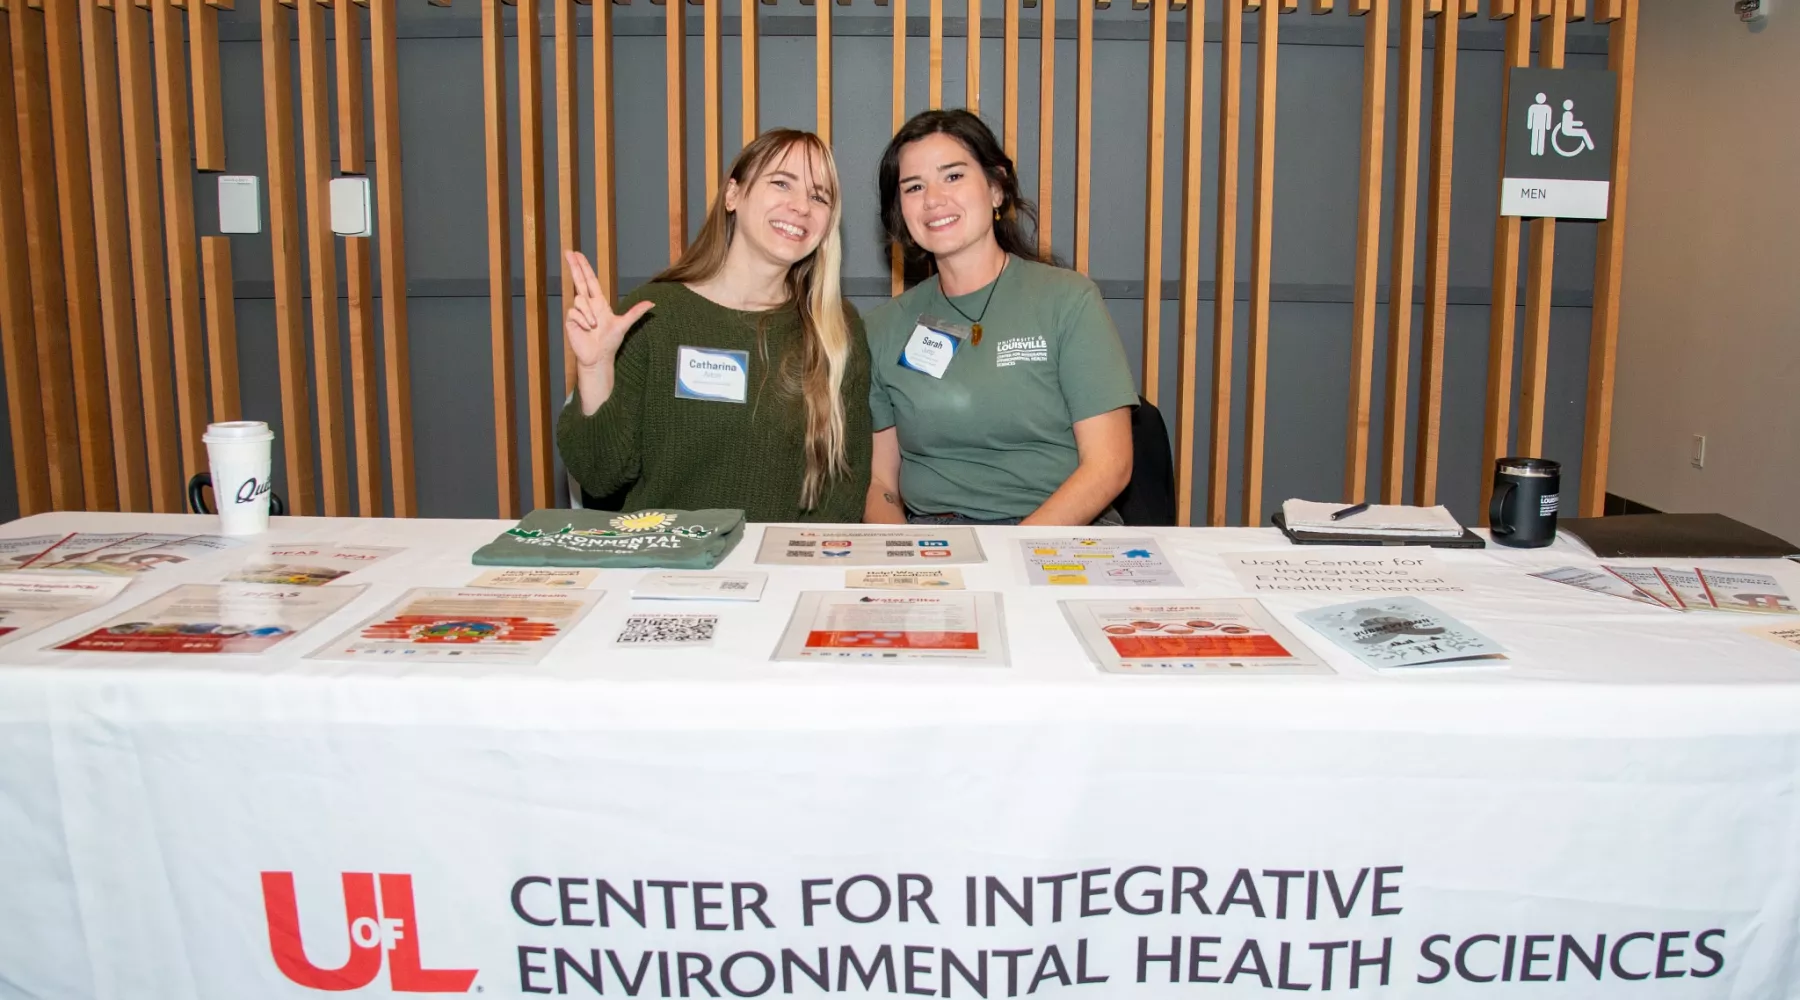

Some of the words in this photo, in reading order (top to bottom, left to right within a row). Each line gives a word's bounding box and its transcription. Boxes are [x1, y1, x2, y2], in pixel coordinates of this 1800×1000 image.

[1520, 188, 1546, 199] MEN
[922, 336, 943, 349] Sarah
[997, 340, 1047, 352] LOUISVILLE
[689, 358, 738, 372] Catharina
[1393, 557, 1423, 566] for
[1275, 567, 1408, 575] Integrative
[1256, 575, 1444, 583] Environmental
[510, 875, 776, 931] CENTER
[801, 873, 940, 927] FOR
[966, 865, 1404, 927] INTEGRATIVE
[351, 916, 404, 949] OF
[517, 938, 1109, 999] ENVIRONMENTAL
[1136, 935, 1393, 991] HEALTH
[1417, 928, 1726, 985] SCIENCES
